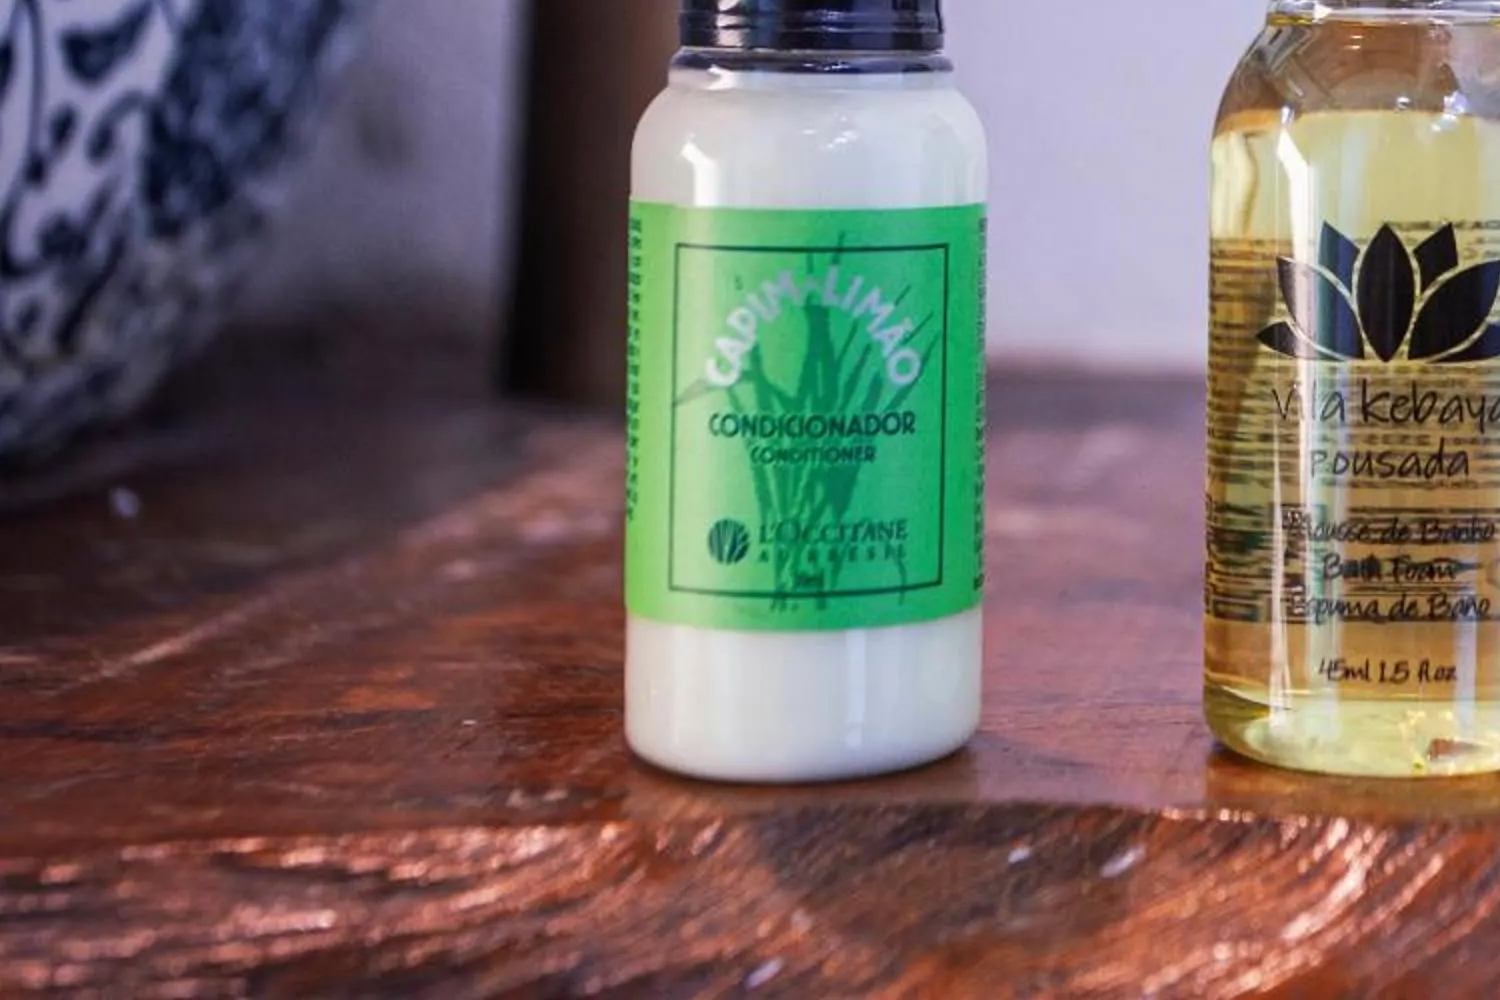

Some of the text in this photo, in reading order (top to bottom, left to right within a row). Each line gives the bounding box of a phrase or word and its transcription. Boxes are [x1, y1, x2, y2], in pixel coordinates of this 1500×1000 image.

[706, 264, 921, 386] CAPIM-LIMÃO
[1271, 379, 1347, 423] Vla
[708, 410, 916, 439] CONDICIONADOR
[751, 445, 877, 465] CONDITIONER
[1319, 657, 1371, 683] 45ml
